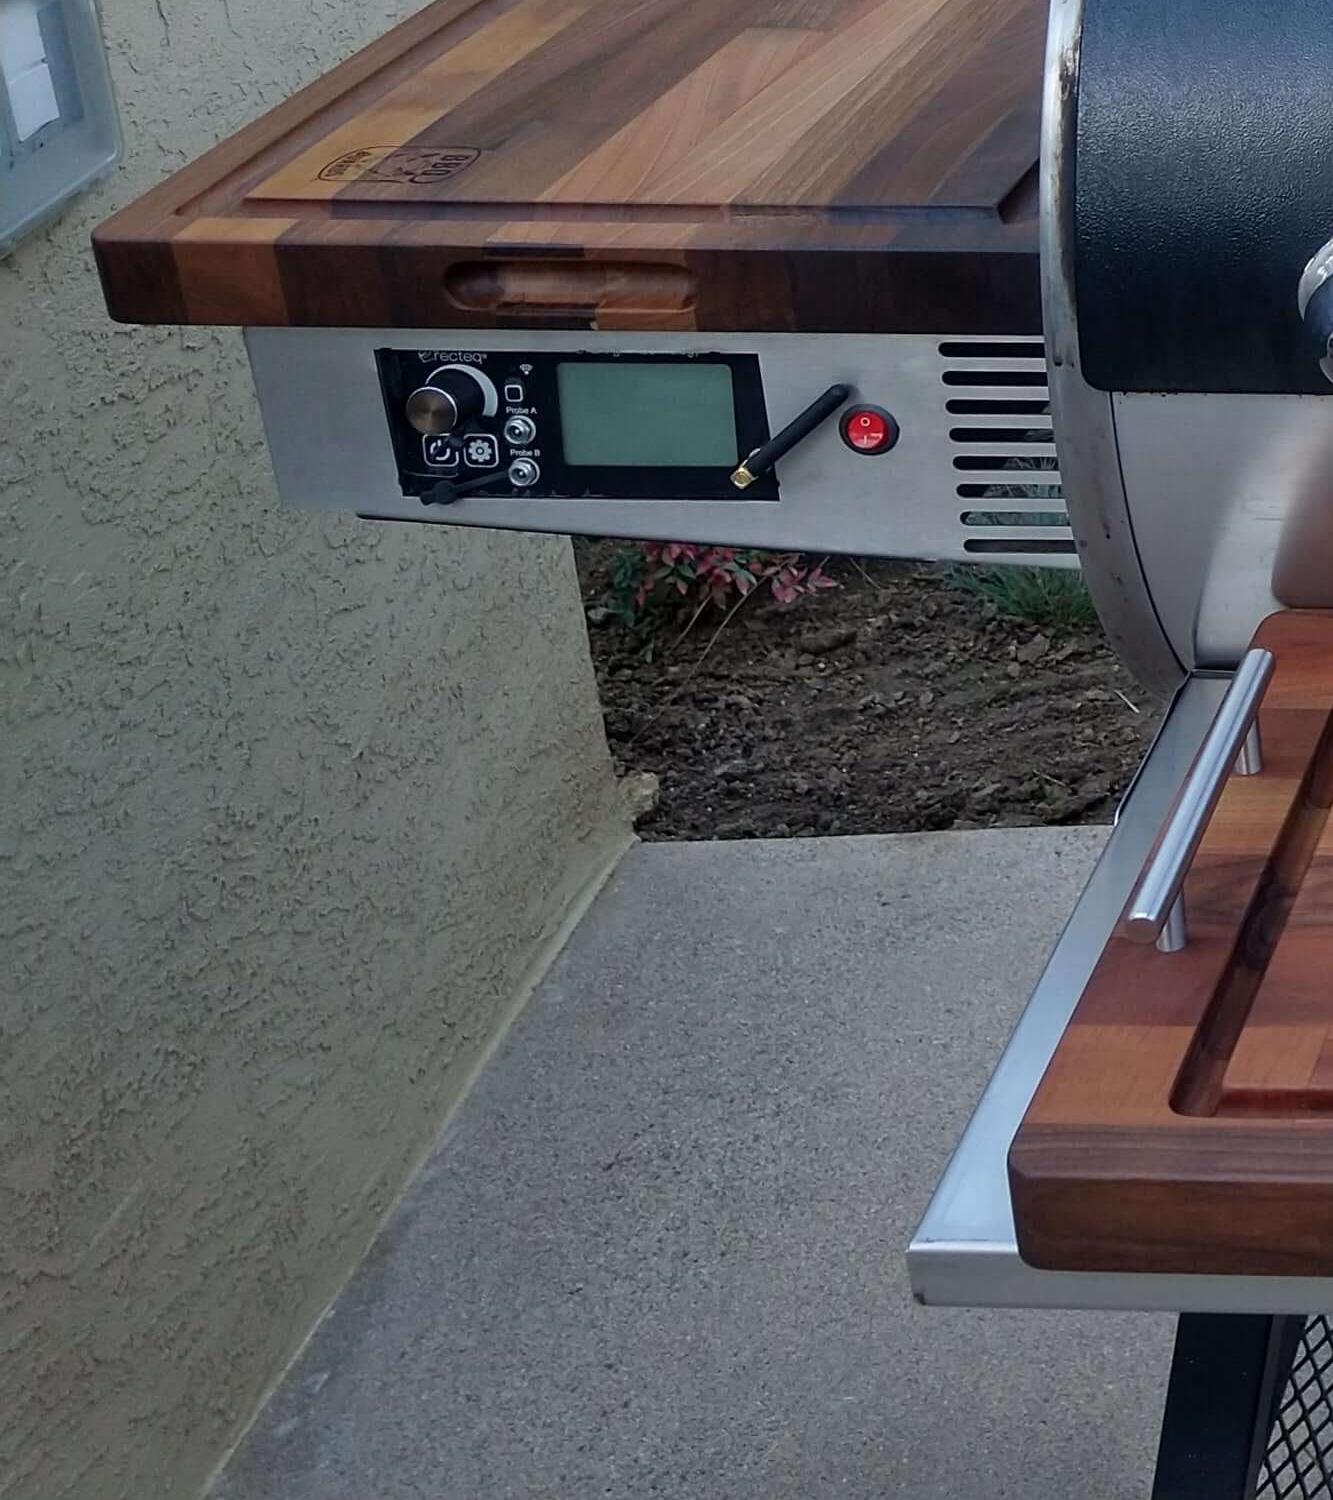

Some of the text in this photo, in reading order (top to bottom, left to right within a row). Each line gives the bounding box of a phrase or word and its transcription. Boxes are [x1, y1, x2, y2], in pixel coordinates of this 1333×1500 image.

[434, 351, 483, 365] recteq
[506, 406, 538, 415] Probe A
[510, 449, 541, 457] Probe B
